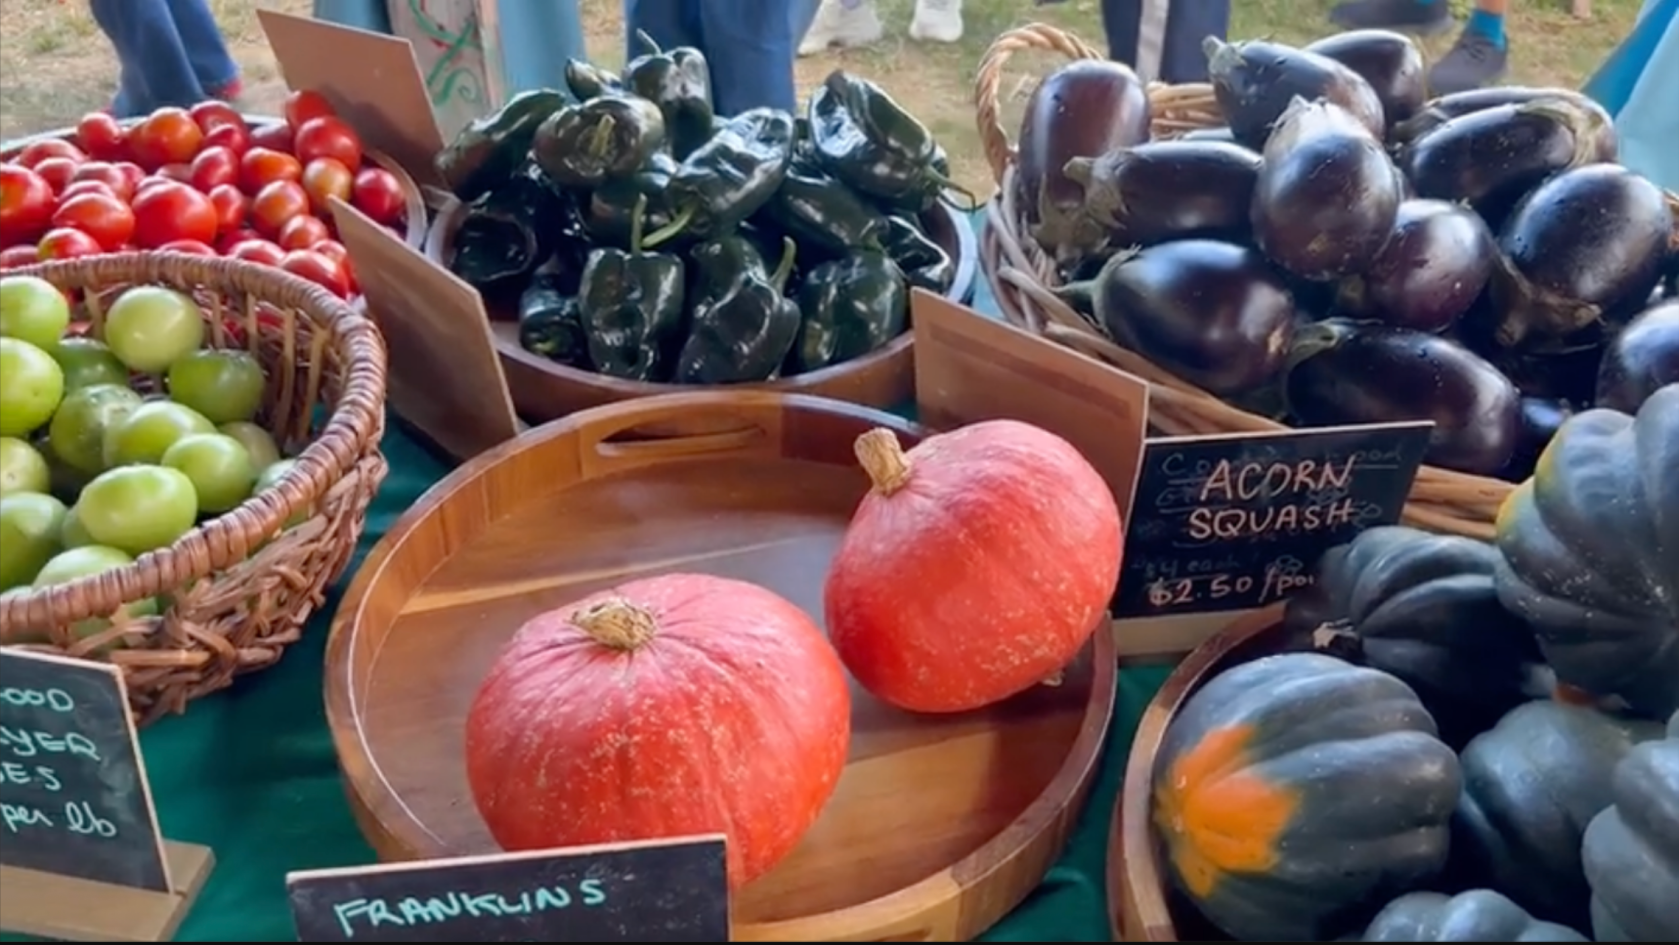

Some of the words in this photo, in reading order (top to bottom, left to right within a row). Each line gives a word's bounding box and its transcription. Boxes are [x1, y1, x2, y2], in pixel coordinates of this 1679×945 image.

[1200, 455, 1356, 501] ACORN
[1188, 498, 1352, 539] SQUASH
[0, 687, 74, 712] OOD
[0, 725, 101, 761] YER
[0, 761, 62, 791] ES
[0, 803, 54, 833] per
[65, 801, 117, 838] lb
[333, 878, 608, 938] FRANKLINS
